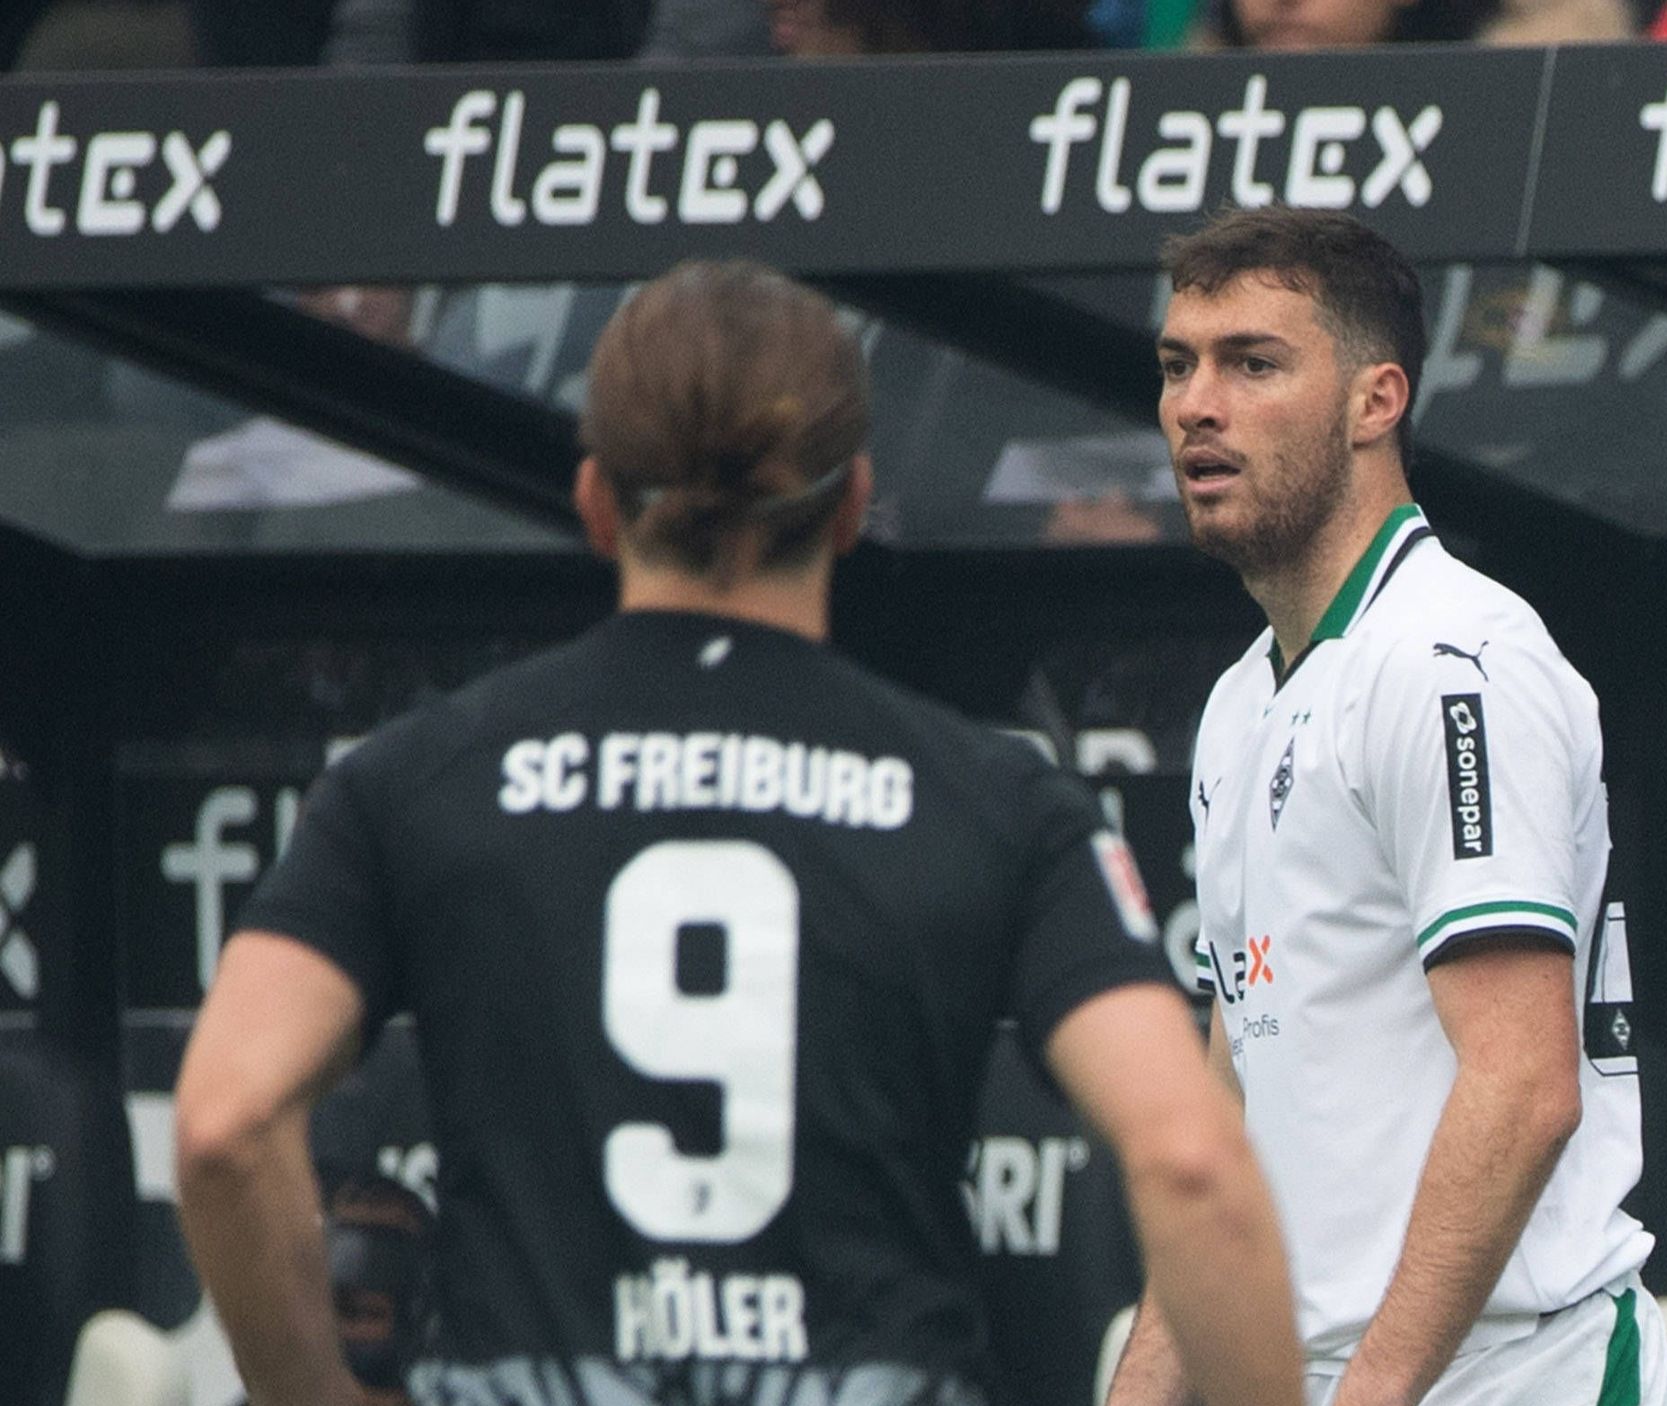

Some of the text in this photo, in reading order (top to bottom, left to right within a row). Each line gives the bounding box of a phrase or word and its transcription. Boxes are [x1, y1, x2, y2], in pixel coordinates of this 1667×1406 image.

[499, 732, 590, 814] SC
[599, 731, 914, 830] FREIBURG
[1456, 736, 1482, 852] sonepar
[603, 838, 799, 1242] 9
[615, 1258, 808, 1364] HÖLER
